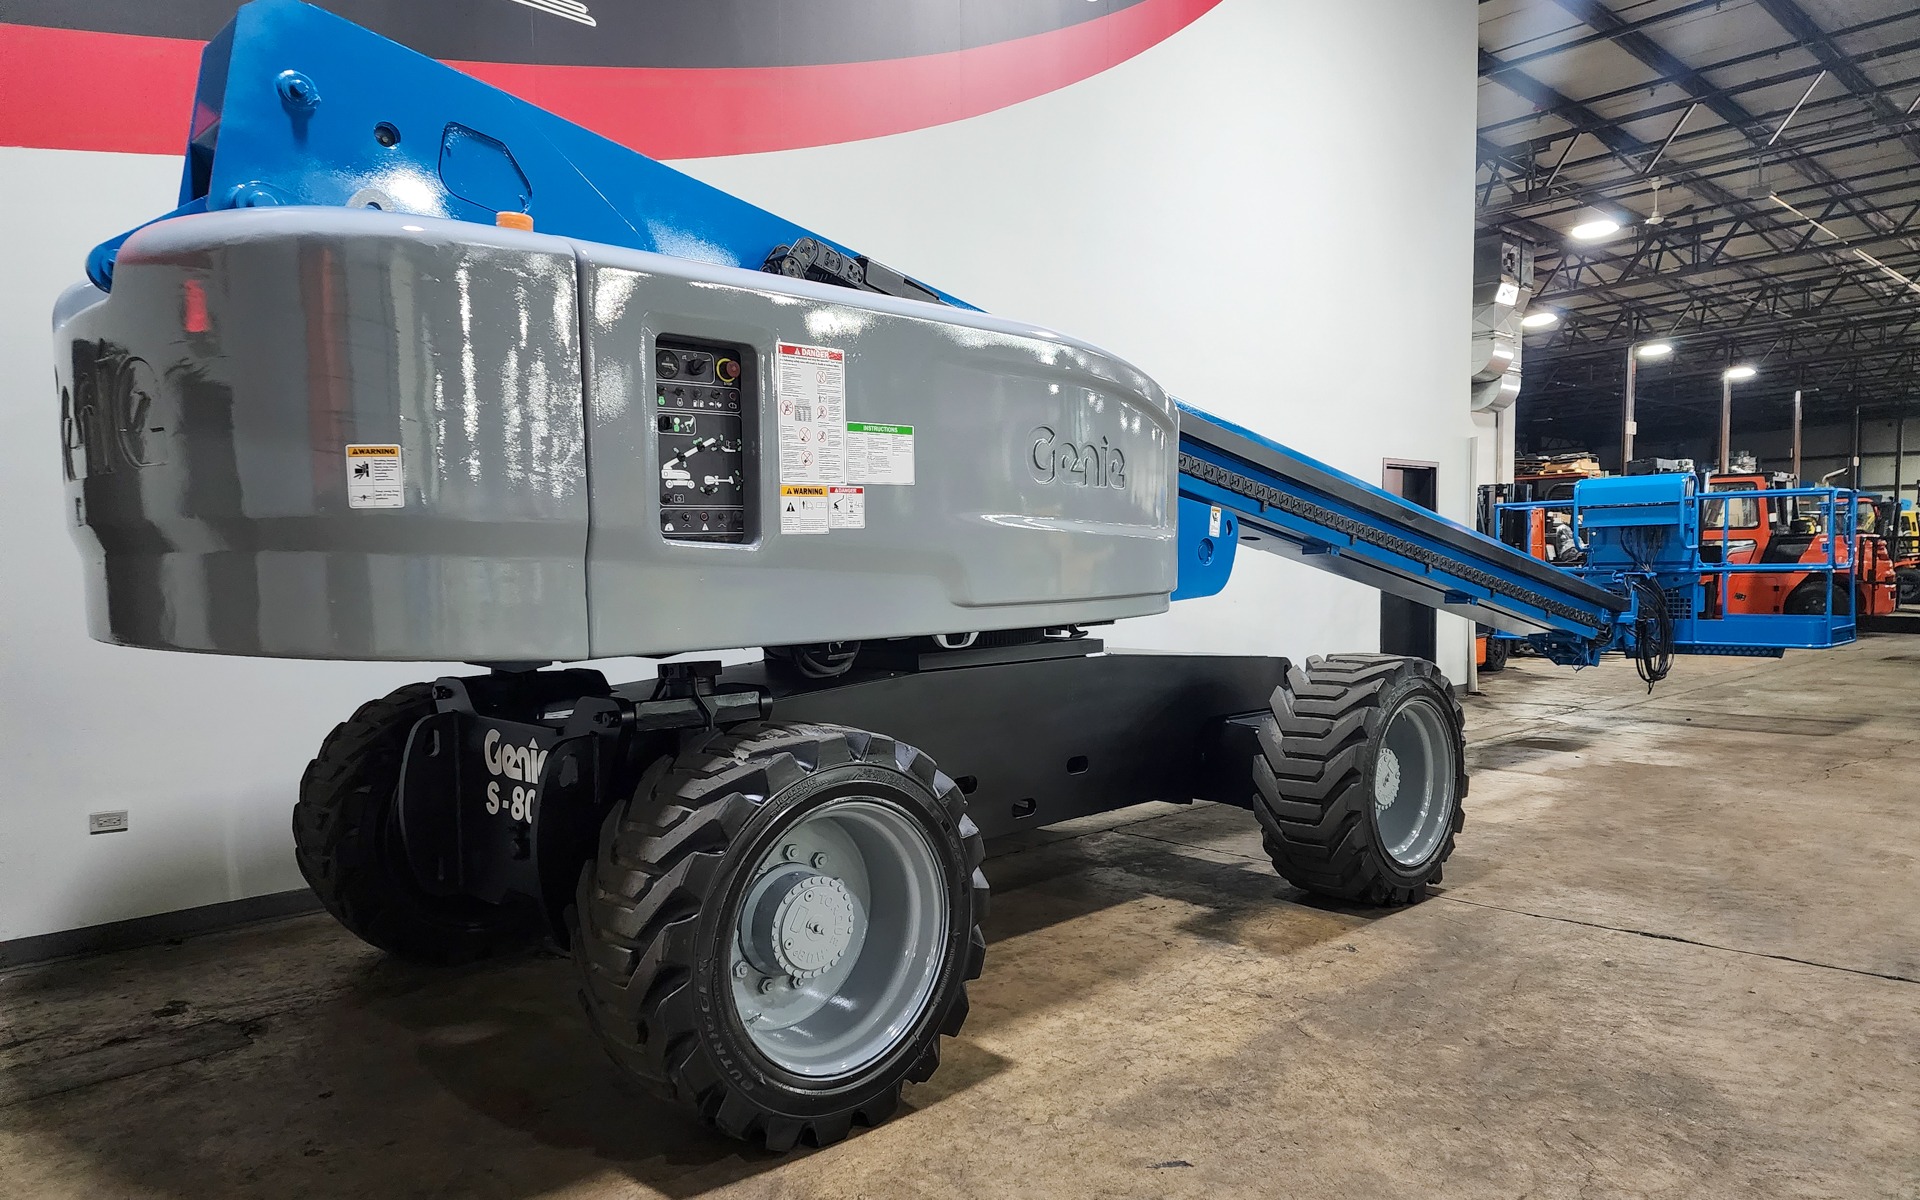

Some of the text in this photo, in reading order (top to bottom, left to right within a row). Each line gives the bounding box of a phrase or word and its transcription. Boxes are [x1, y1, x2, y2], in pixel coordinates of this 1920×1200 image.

[802, 348, 829, 359] DANGER
[863, 425, 898, 433] INSTRUCTIONS
[1025, 423, 1125, 489] Genie
